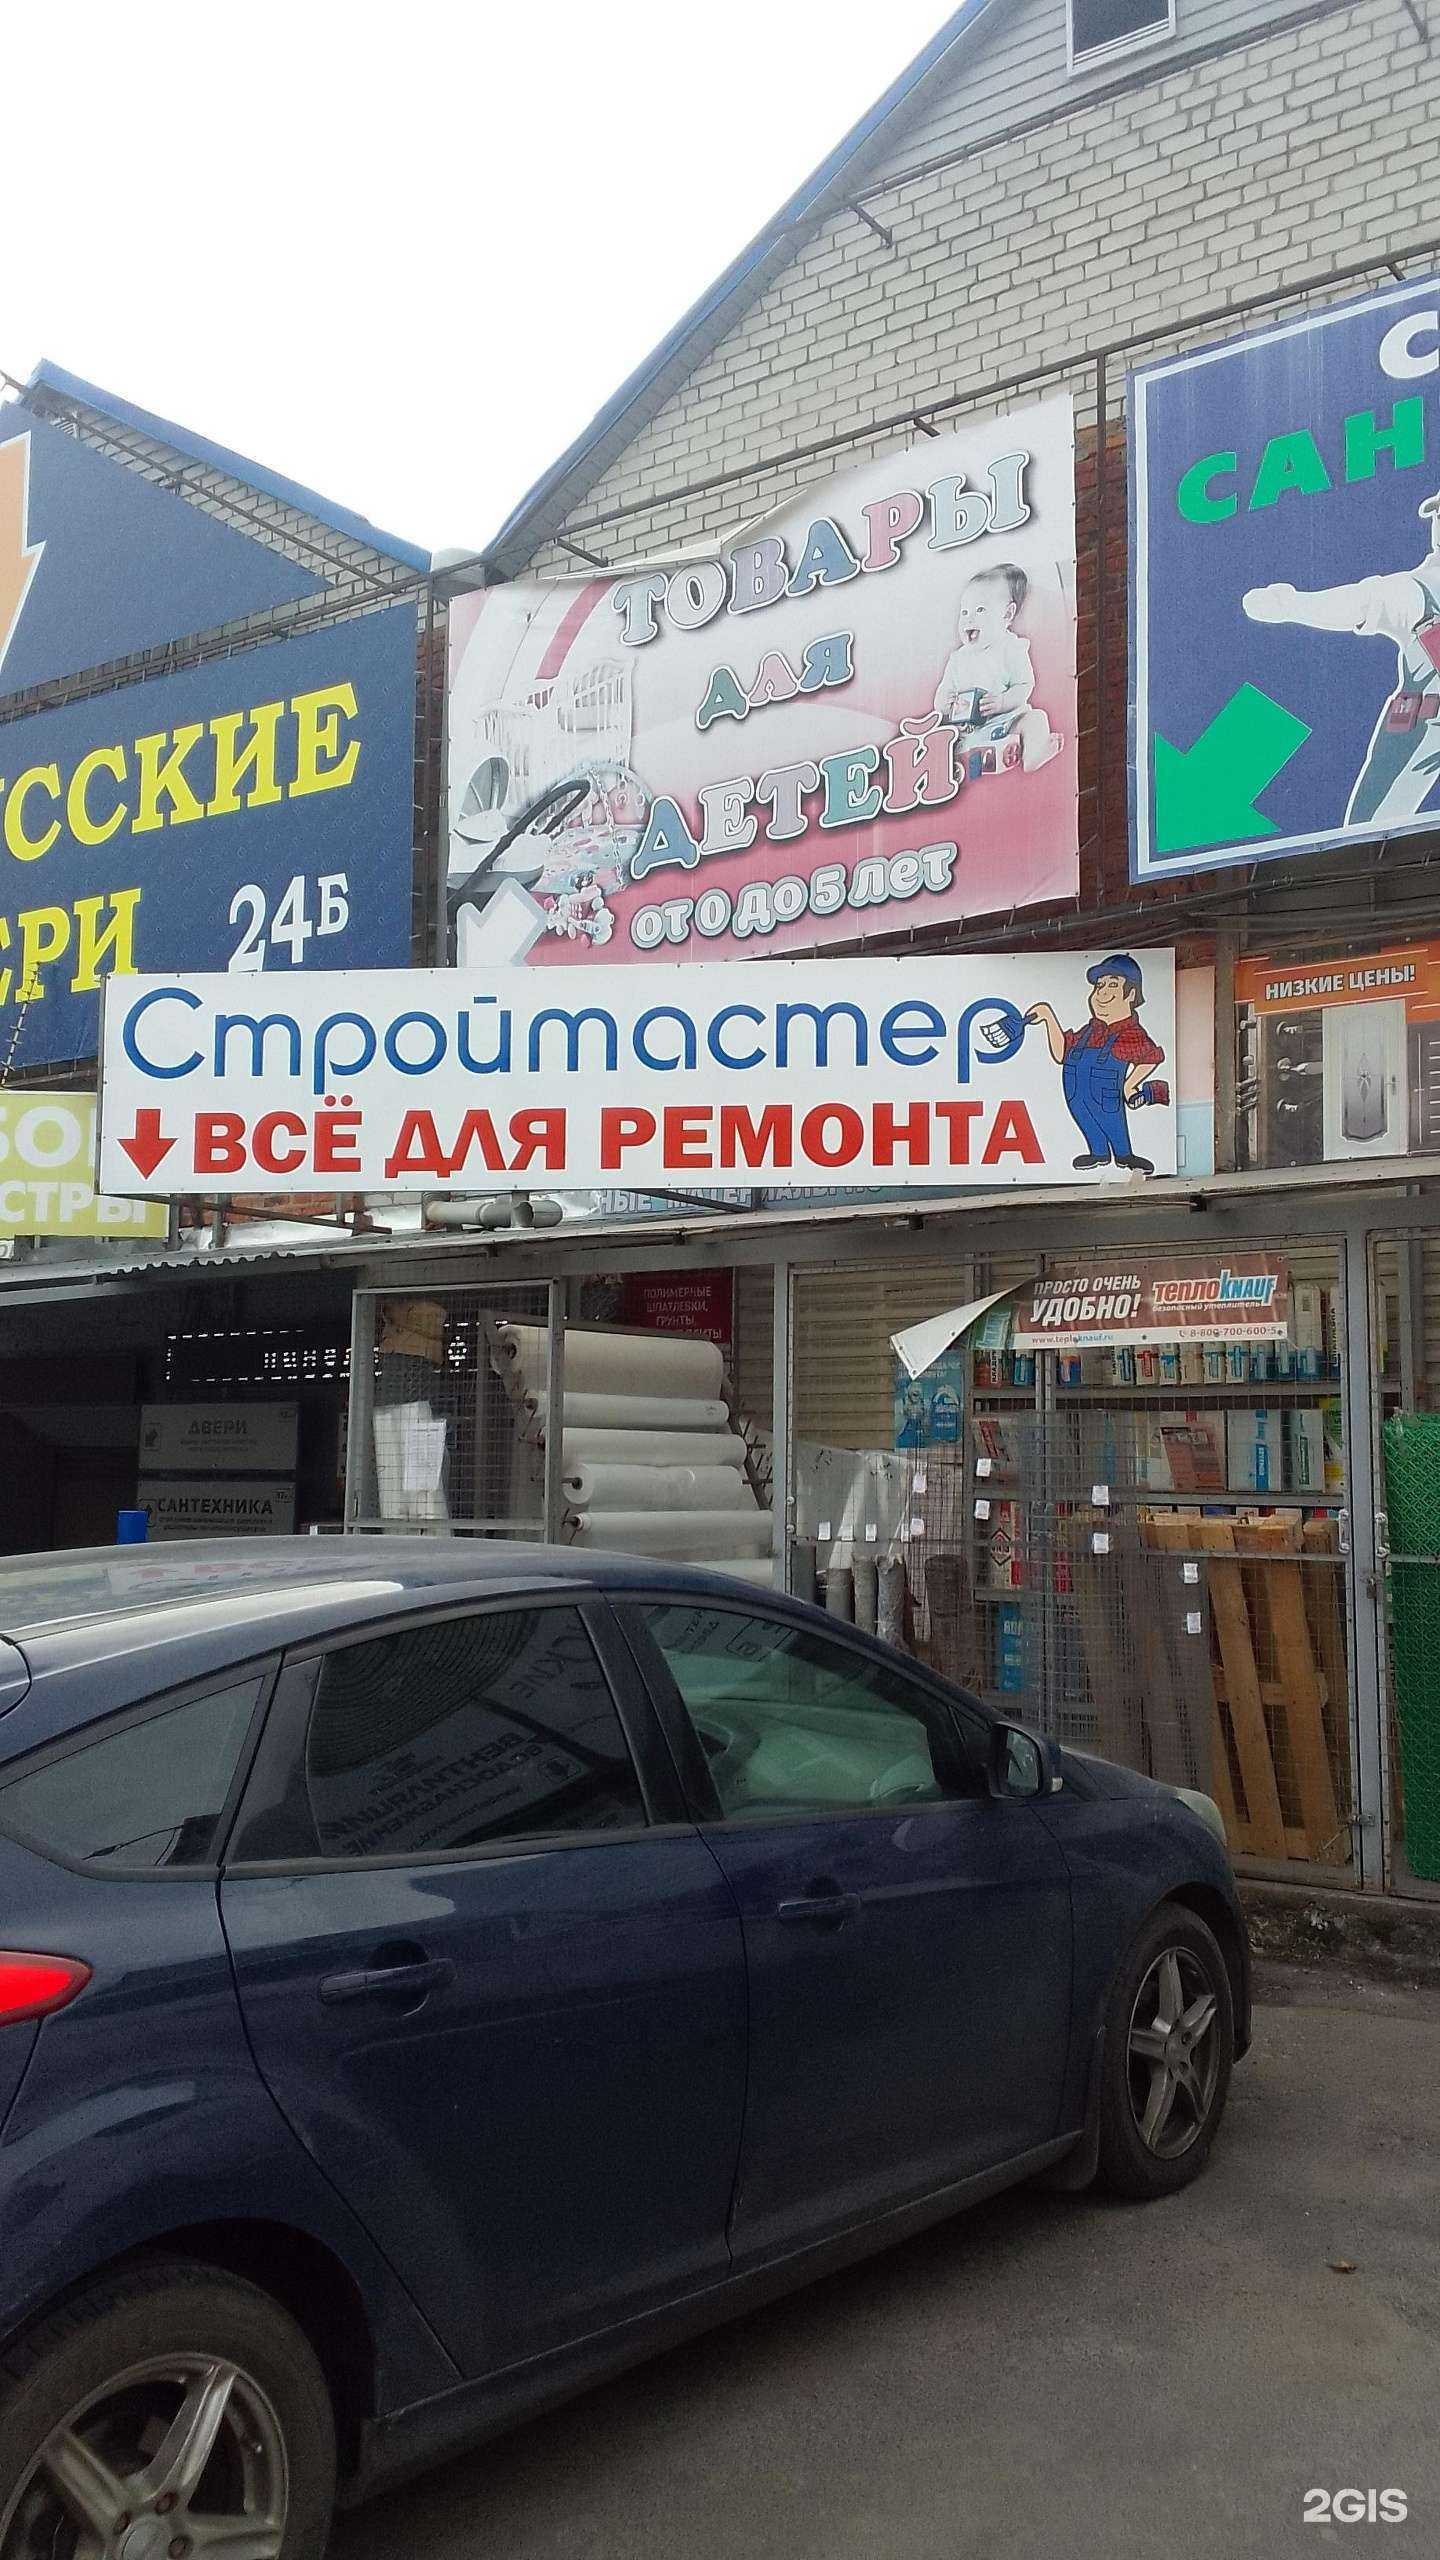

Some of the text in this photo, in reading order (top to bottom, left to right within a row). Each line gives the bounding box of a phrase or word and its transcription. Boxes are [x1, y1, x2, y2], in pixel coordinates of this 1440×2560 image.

[612, 450, 1031, 646] ТОВАРЫ
[696, 631, 854, 729] ДЛЯ
[0, 682, 361, 861] ССКИЕ
[631, 712, 960, 880] ДЕТЕЙ
[0, 888, 141, 1006] РИ
[1265, 964, 1416, 1000] НИЗКИЕ ЦЕНЫ!
[194, 1095, 1046, 1178] ВСЁ ДЛЯ РЕМОНТА
[644, 1286, 712, 1299] ПОЛИМЕРНЫЕ
[1034, 1275, 1141, 1295] ПРОСТО ОЧЕНЬ
[1030, 1294, 1141, 1326] УДОБНО!
[1032, 1333, 1113, 1345] www.teplknauf.ru
[188, 1418, 247, 1435] ДВЕРИ
[158, 1498, 273, 1515] САНТЕХНИКА
